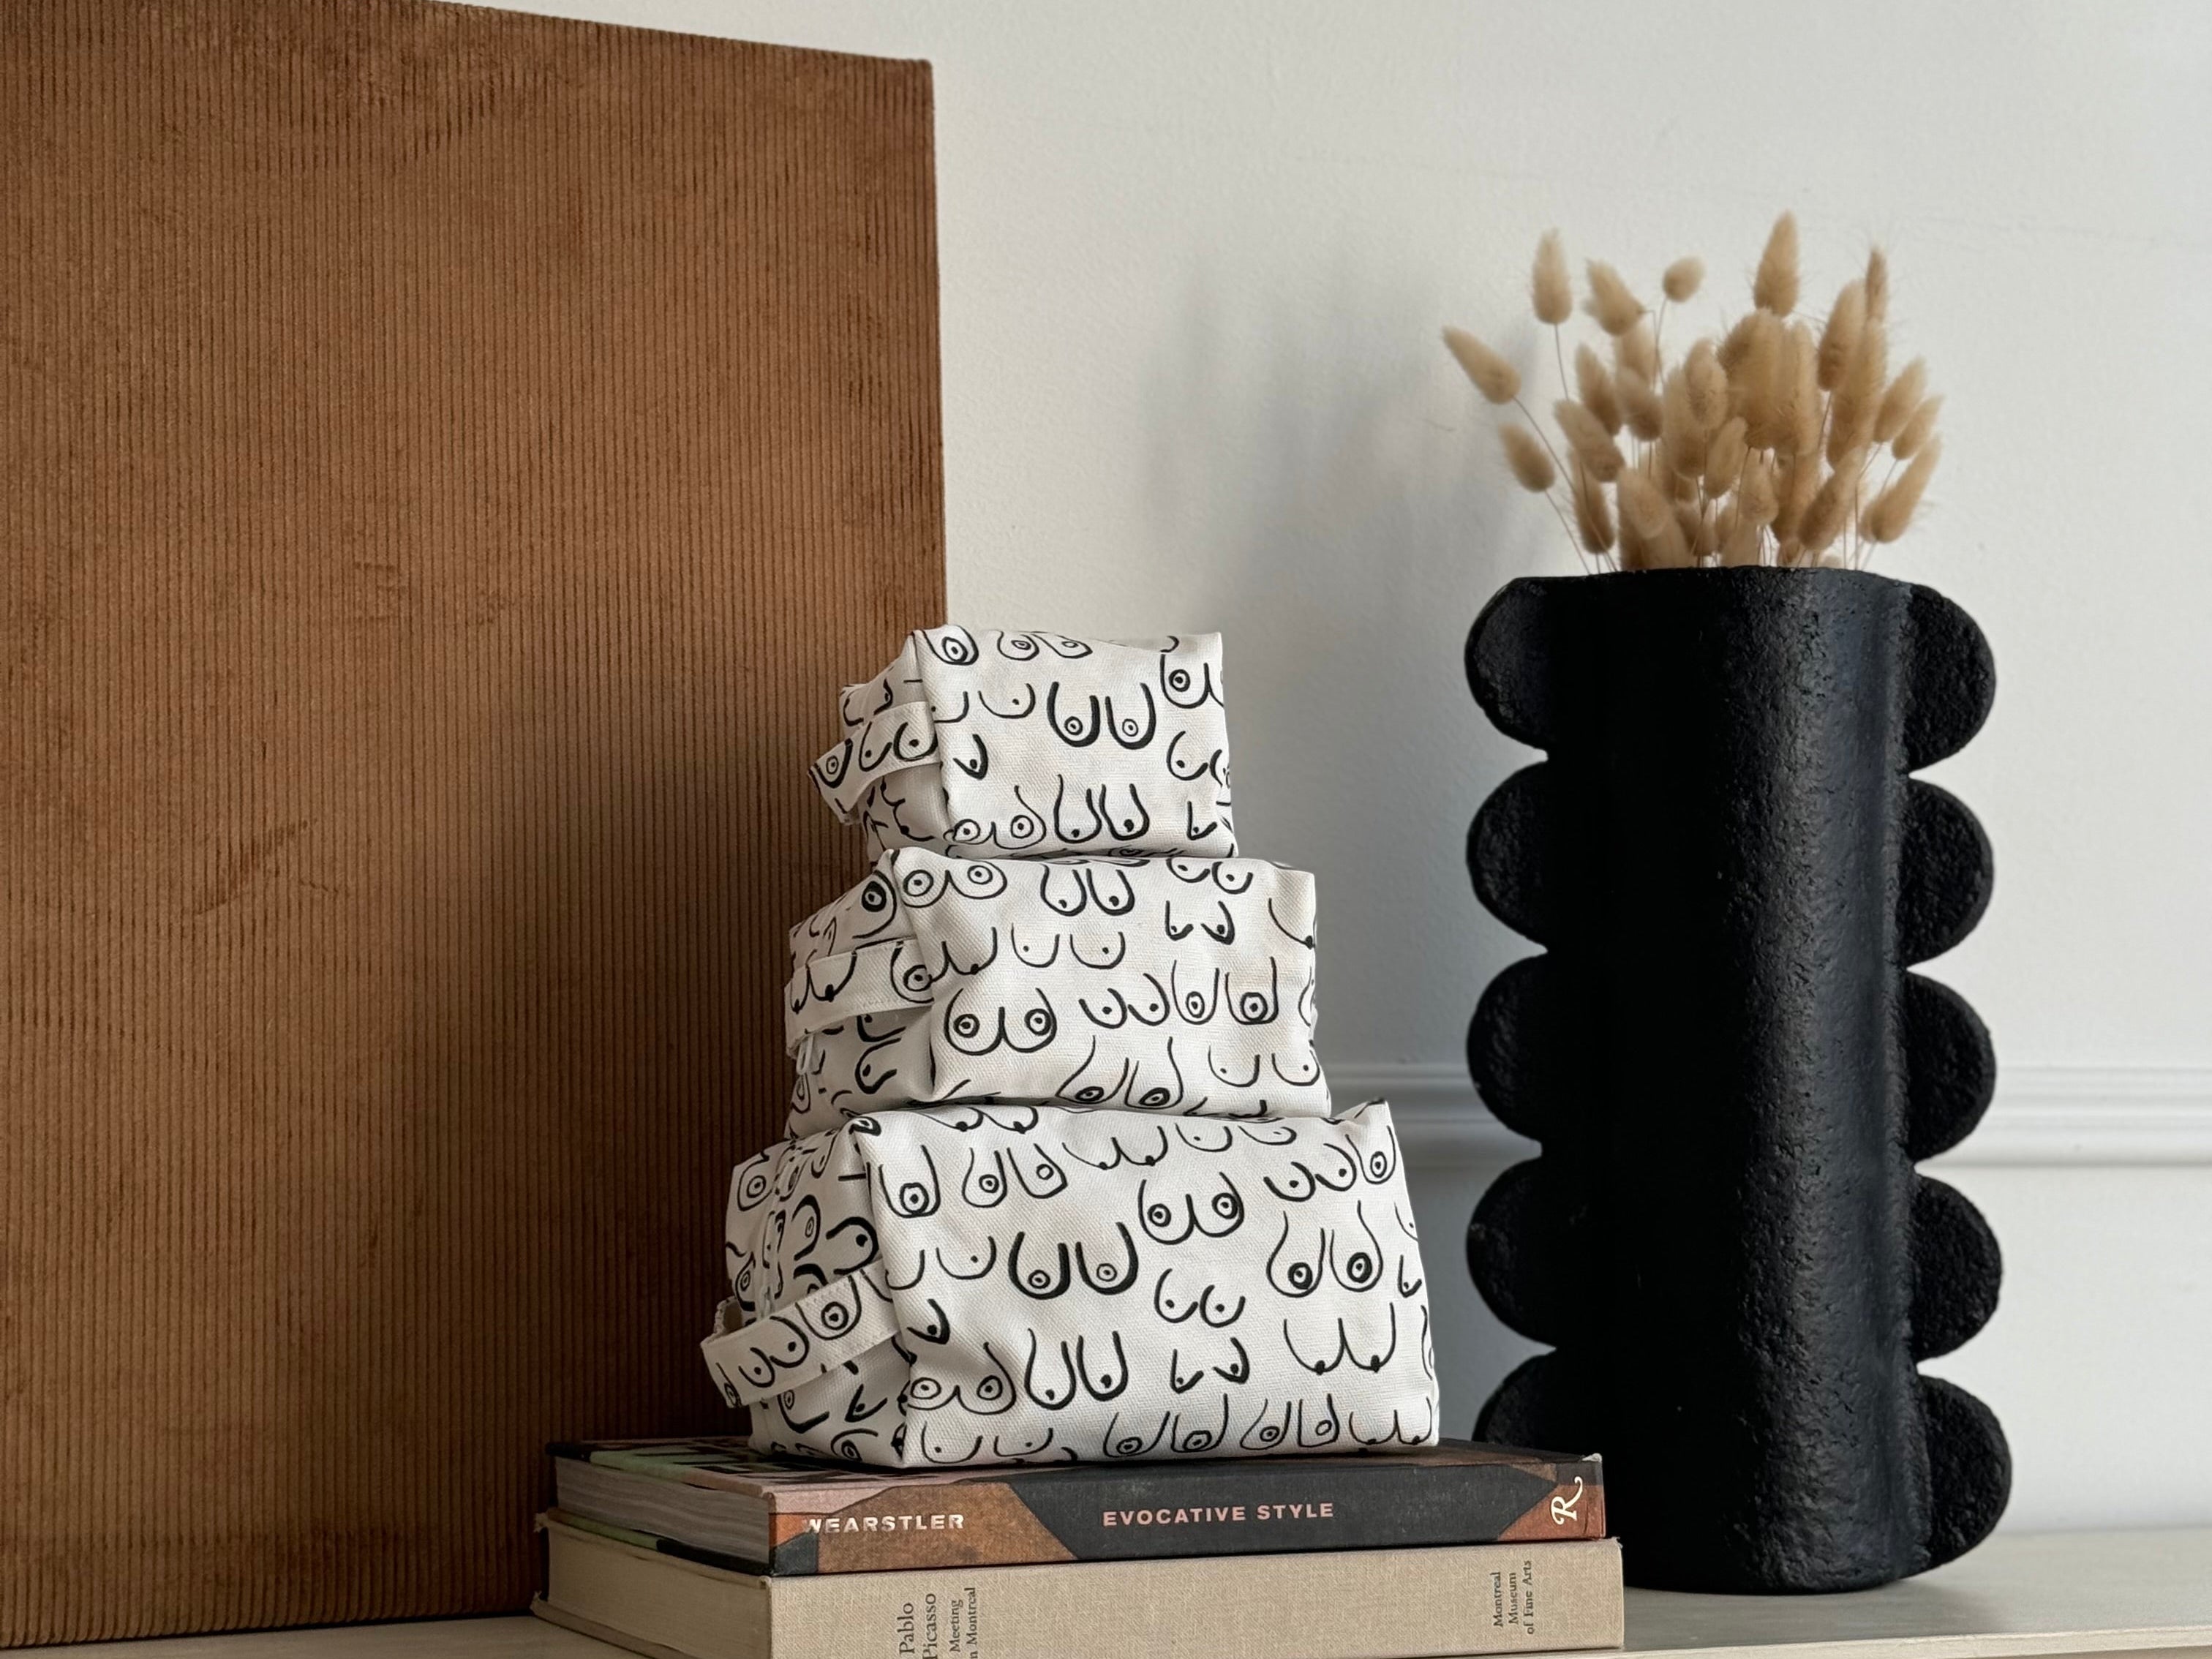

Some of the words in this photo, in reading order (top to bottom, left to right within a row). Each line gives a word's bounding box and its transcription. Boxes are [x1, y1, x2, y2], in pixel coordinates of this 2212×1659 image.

[804, 1514, 964, 1534] WEARSTLER
[1103, 1506, 1246, 1527] EVOCATIVE
[1257, 1503, 1333, 1520] STYLE
[1508, 1572, 1519, 1625] Museum
[1522, 1560, 1532, 1586] Arts
[922, 1593, 937, 1659] Picasso
[949, 1599, 964, 1652] Meeting
[964, 1587, 977, 1645] Montreal
[1490, 1572, 1503, 1628] Montreal
[1524, 1590, 1534, 1617] Fine
[897, 1603, 915, 1655] Pablo
[1523, 1621, 1535, 1635] of
